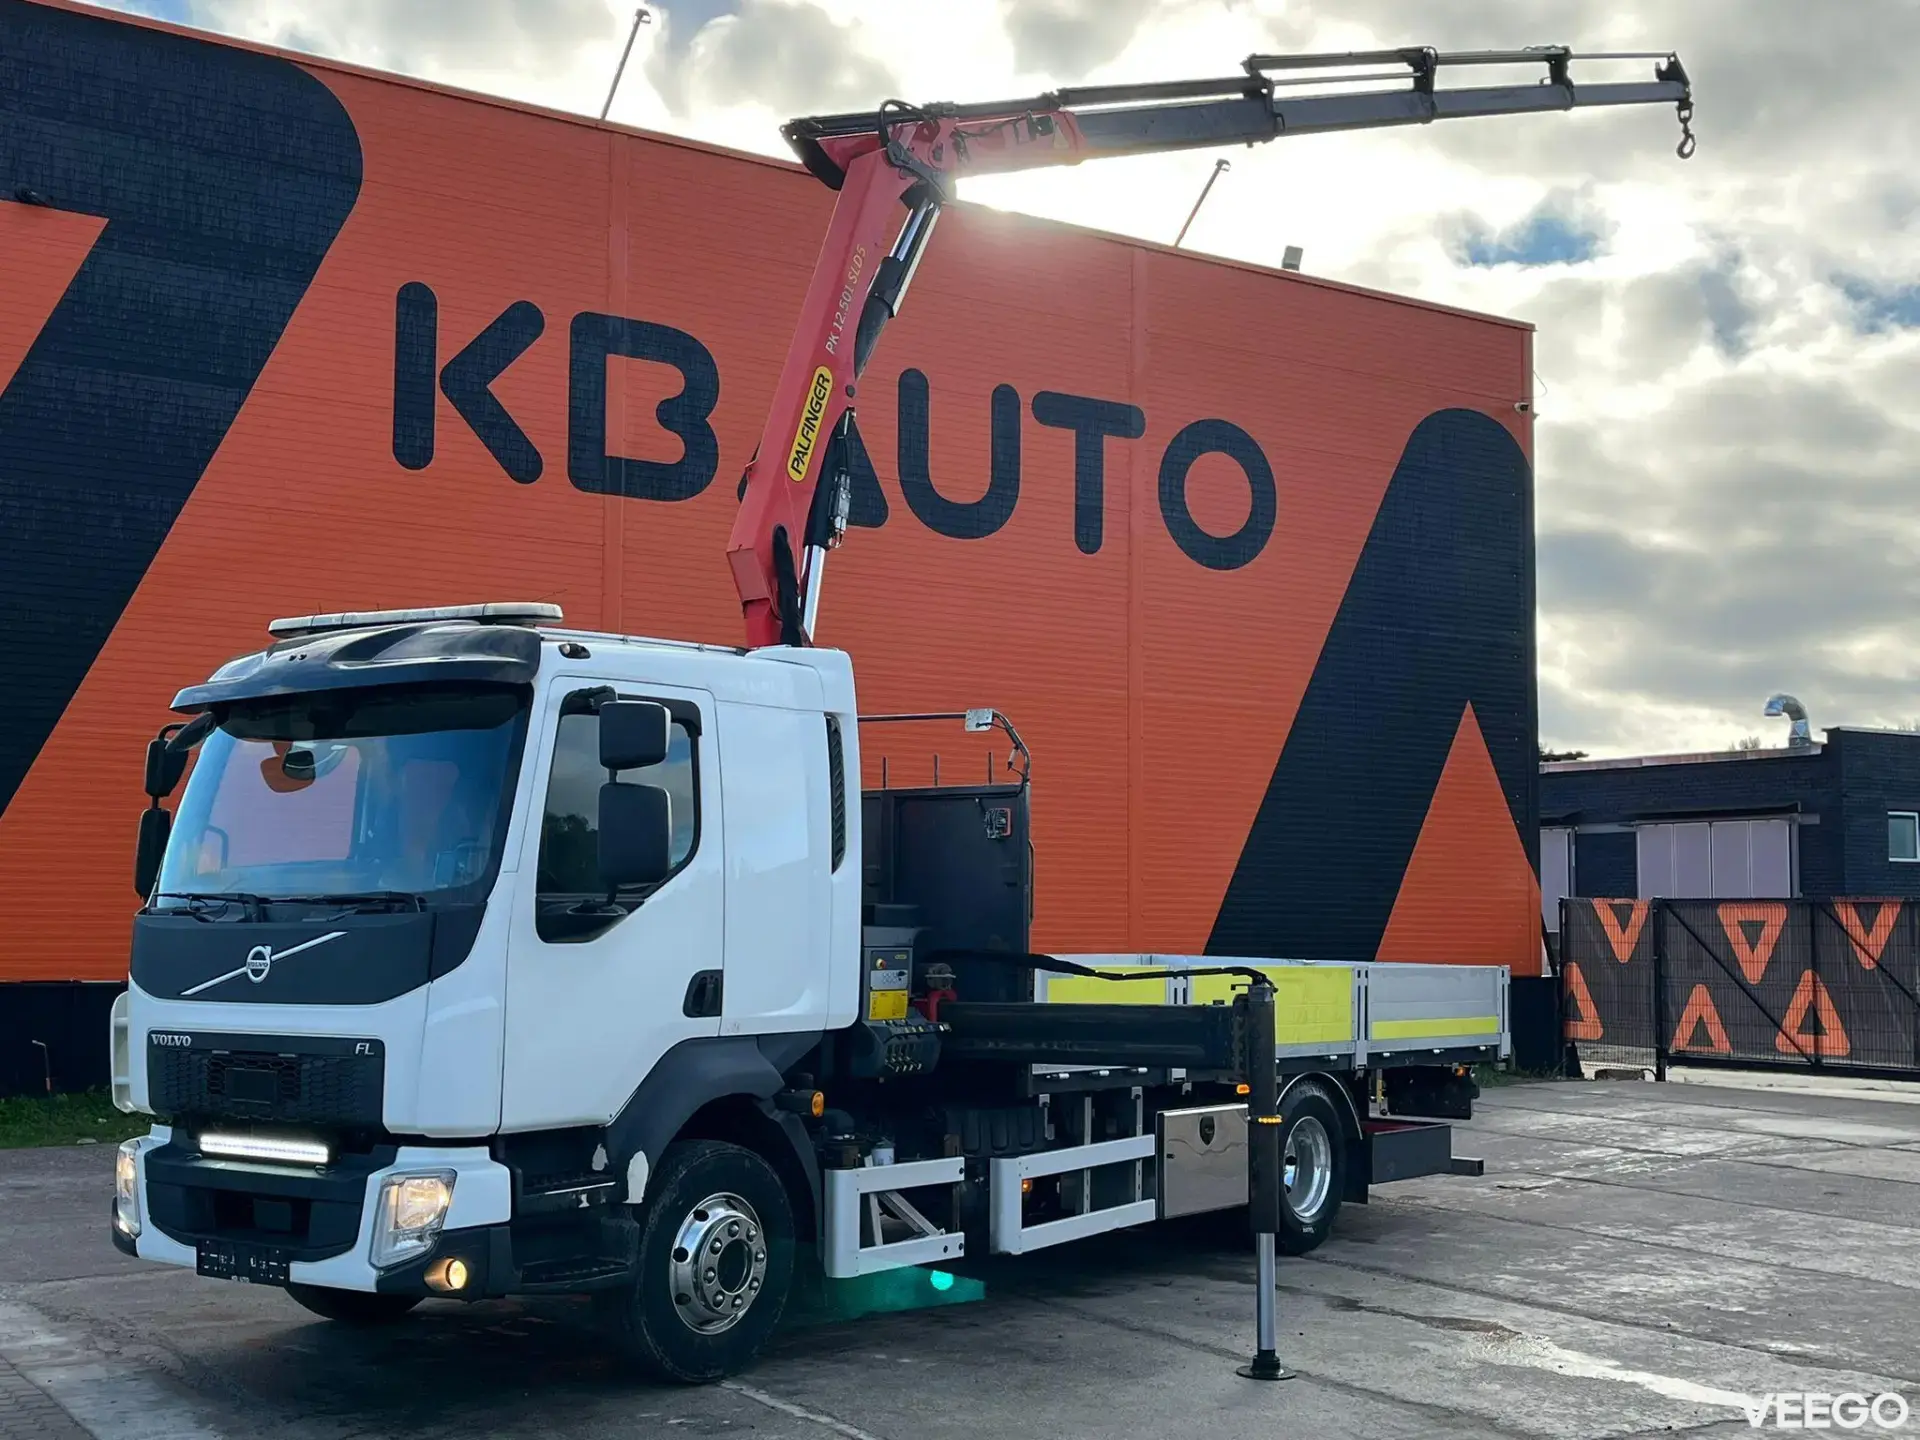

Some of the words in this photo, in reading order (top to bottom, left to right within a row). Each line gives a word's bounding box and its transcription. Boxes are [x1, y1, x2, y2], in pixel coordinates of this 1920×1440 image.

[847, 243, 866, 285] SLD5
[832, 285, 855, 332] 12.501
[825, 332, 840, 355] PK
[790, 373, 831, 475] PALFINGER
[151, 1033, 192, 1047] VOLVO
[355, 1042, 375, 1056] FL
